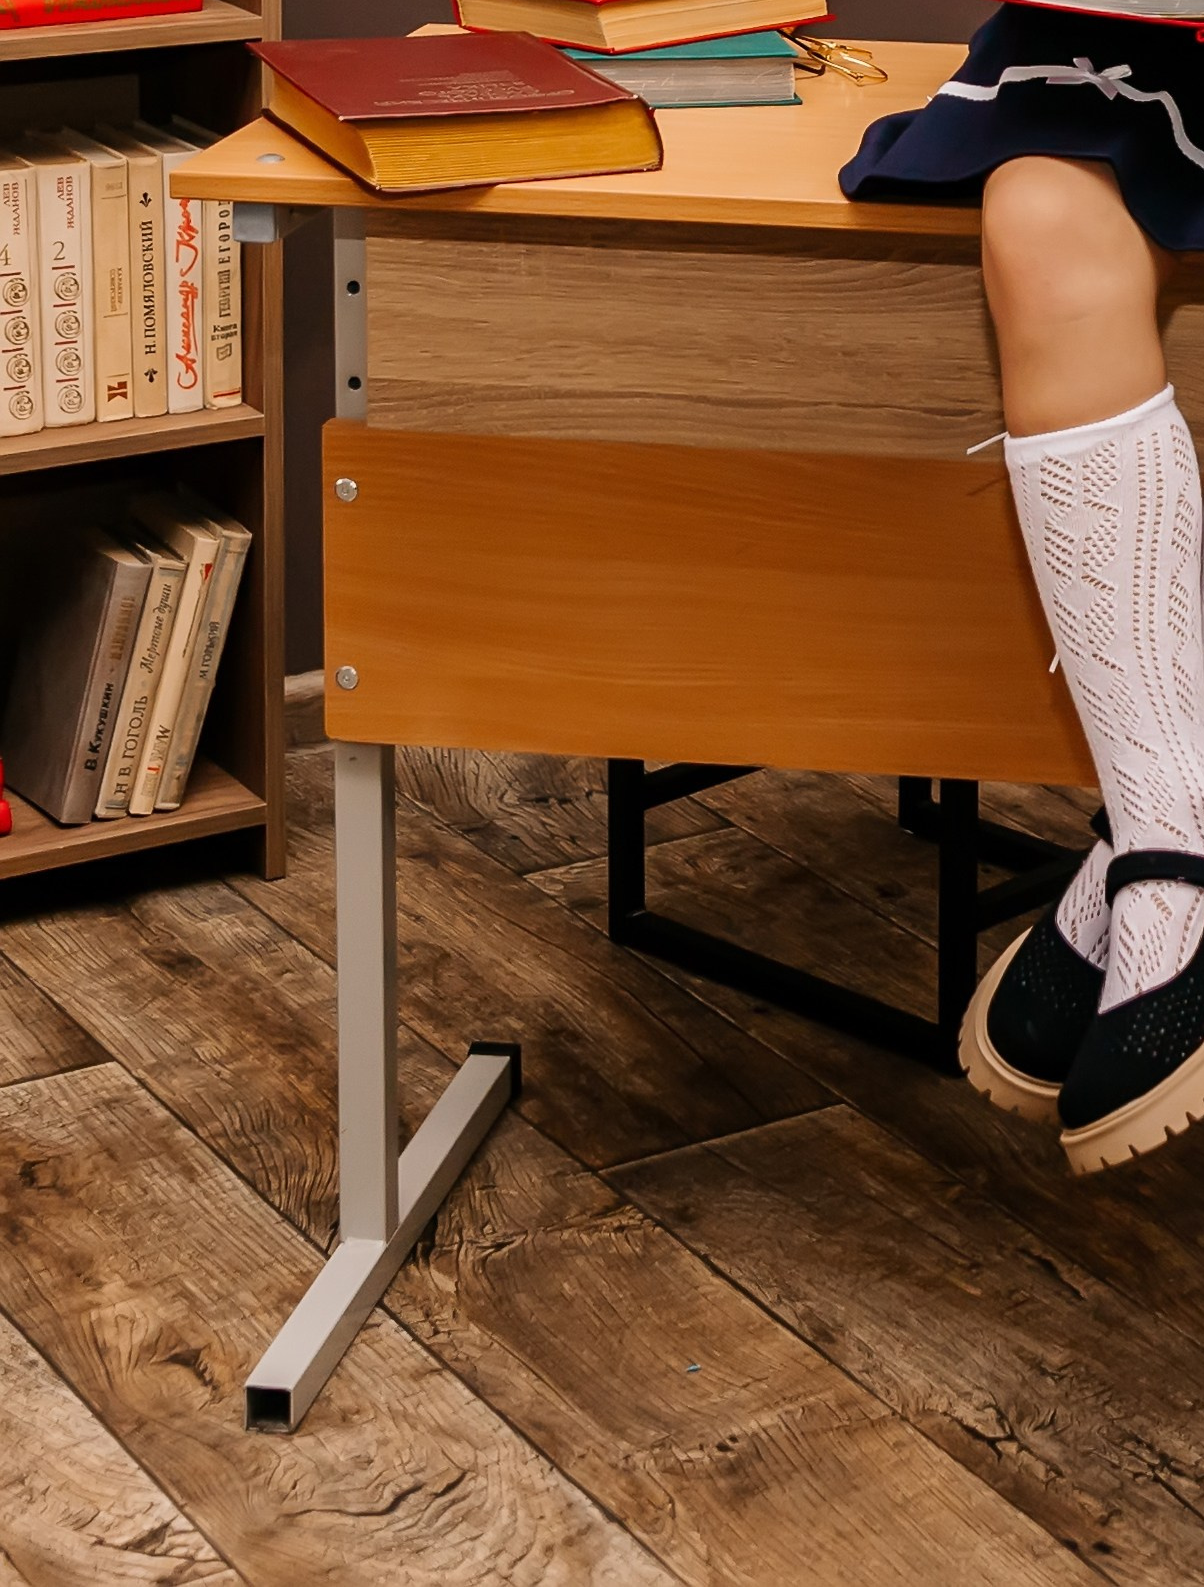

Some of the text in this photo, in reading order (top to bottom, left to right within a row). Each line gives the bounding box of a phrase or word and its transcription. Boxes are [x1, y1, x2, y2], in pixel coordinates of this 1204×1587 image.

[2, 181, 11, 206] ЛЕВ
[12, 180, 21, 236] ЖДАНОВ
[56, 175, 65, 200] ЛЕВ
[65, 174, 75, 230] ЖДАНОВ
[52, 240, 66, 261] 2
[140, 219, 157, 355] Н. ПОМЯЛОВСКИЙ
[217, 269, 232, 318] ГЕОРГИЙ
[200, 620, 221, 670] ГОРЬКИЙ
[121, 694, 149, 760] ГОГОЛЬ
[152, 582, 173, 615] души
[88, 681, 114, 754] Кукушкин
[84, 755, 98, 771] В.
